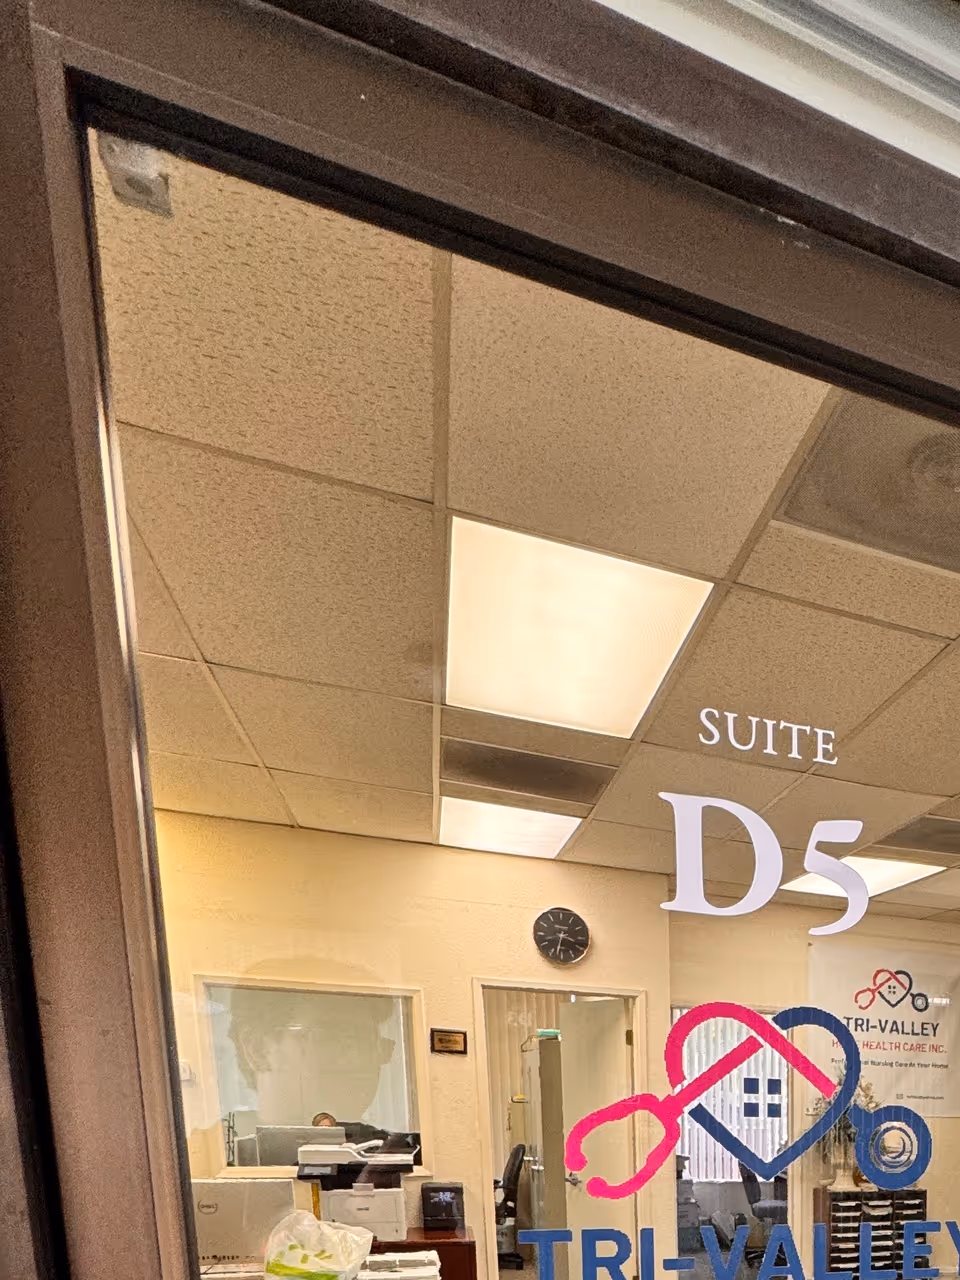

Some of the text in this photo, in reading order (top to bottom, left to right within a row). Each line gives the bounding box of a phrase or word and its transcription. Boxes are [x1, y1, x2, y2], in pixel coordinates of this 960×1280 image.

[699, 707, 838, 765] SUITE
[659, 791, 869, 936] D5
[843, 1016, 940, 1037] TRI-VALLEY
[862, 1041, 901, 1051] HEALTH
[903, 1042, 927, 1053] CARE
[929, 1044, 948, 1054] INC.
